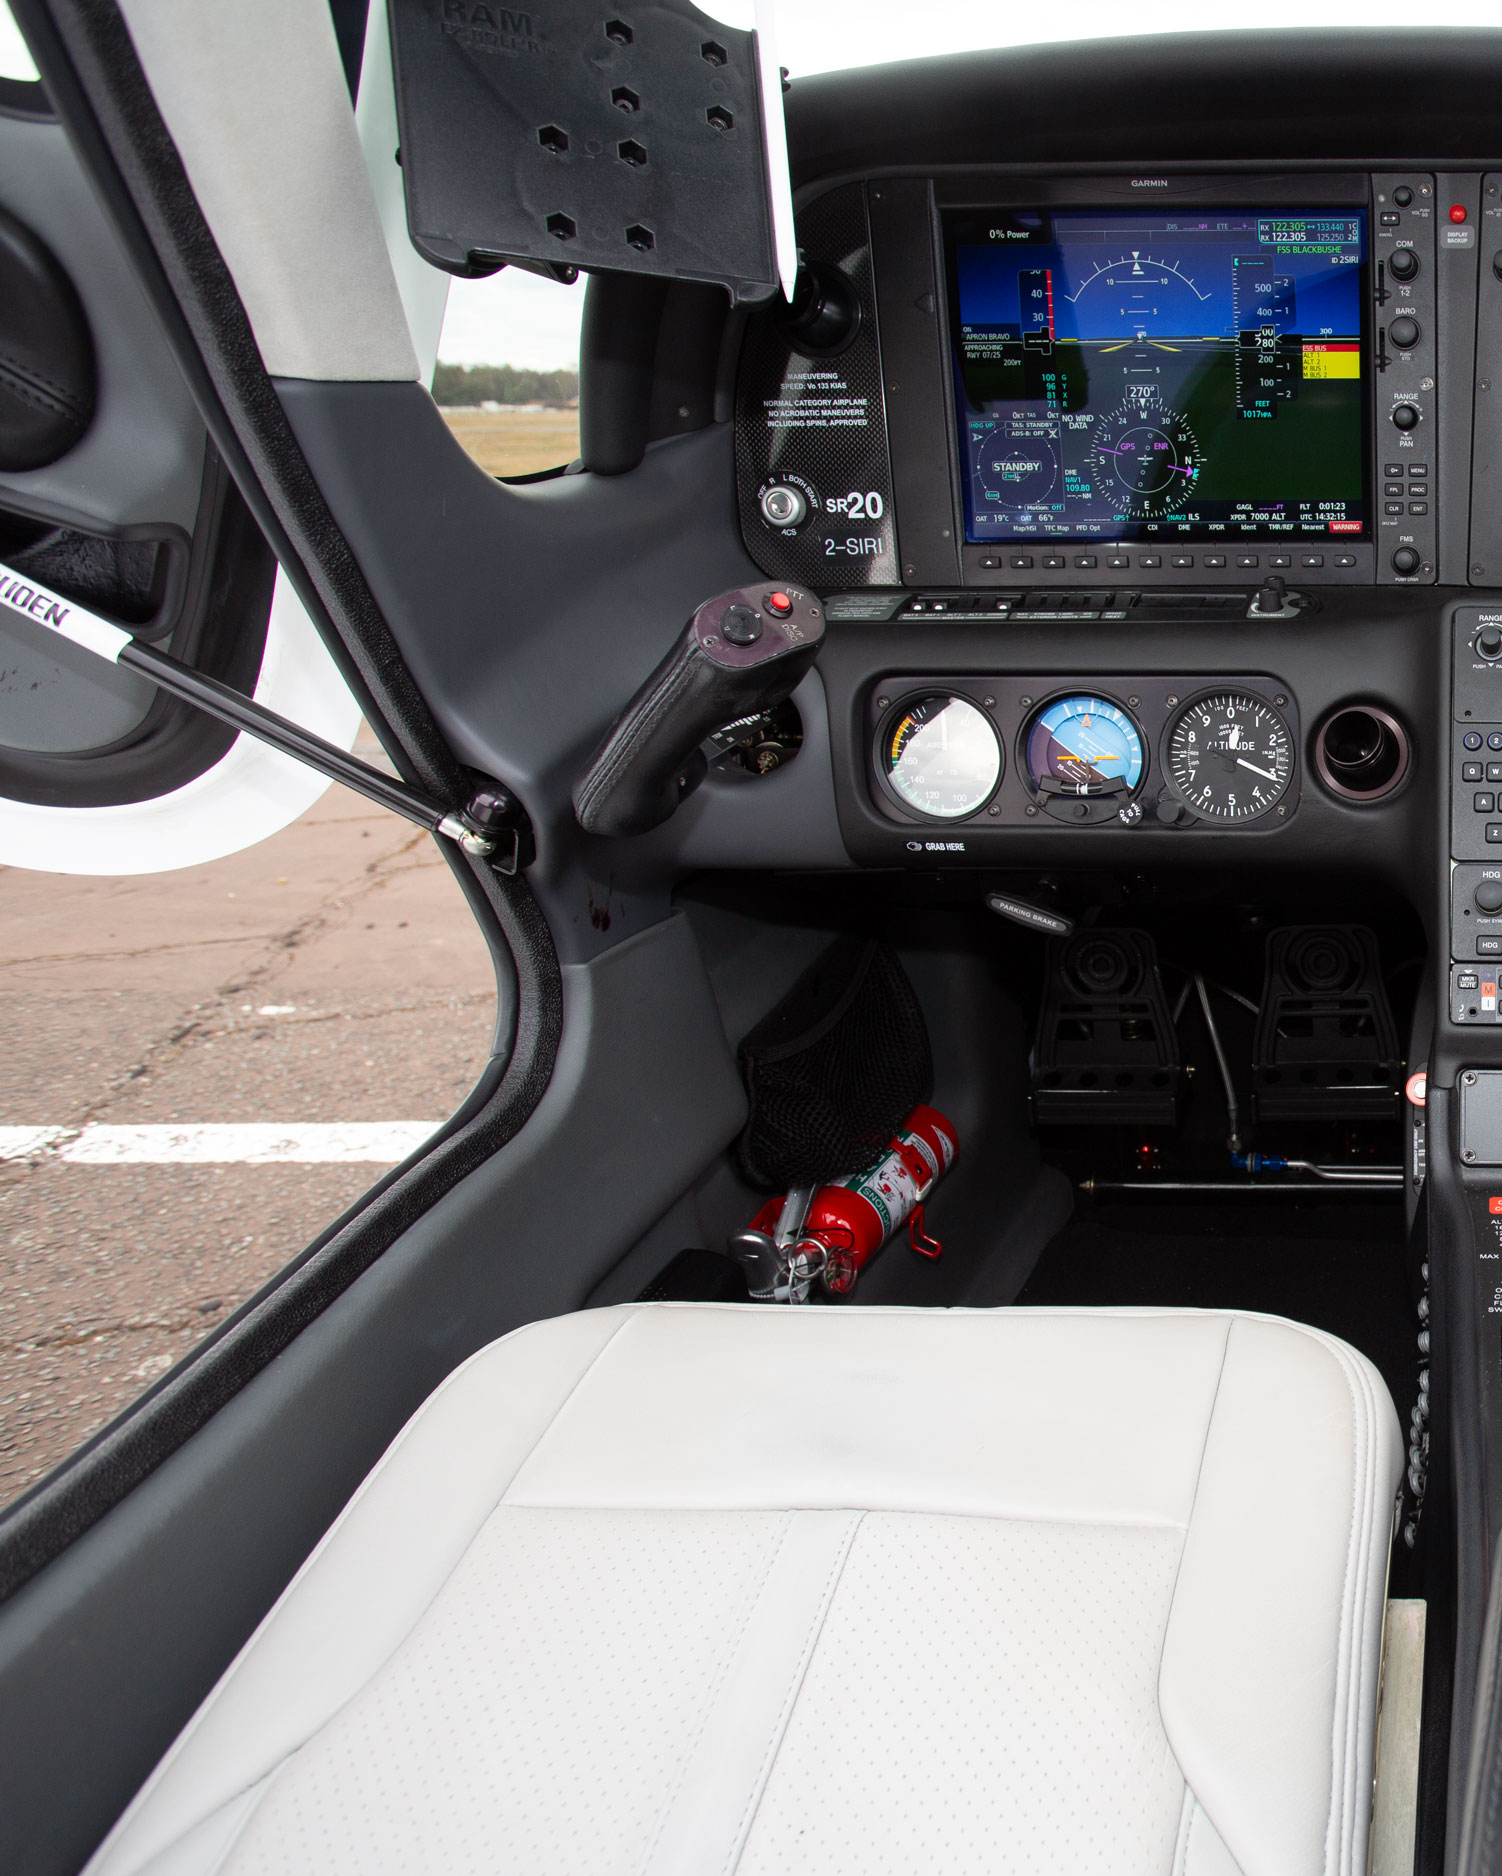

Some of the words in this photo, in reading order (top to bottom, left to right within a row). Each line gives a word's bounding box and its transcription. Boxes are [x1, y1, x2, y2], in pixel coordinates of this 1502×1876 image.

[1272, 223, 1306, 231] 122.305
[990, 230, 1004, 238] 0%
[1272, 233, 1306, 241] 122.305
[1130, 387, 1154, 397] 270°
[1069, 422, 1088, 430] DATA
[993, 462, 1039, 471] STANDBY
[826, 492, 883, 519] SR20
[1250, 513, 1269, 521] 7000
[825, 538, 883, 555] 2-SIRI
[946, 842, 965, 850] HERE
[1000, 902, 1030, 917] PARKING
[1033, 915, 1056, 927] BRAKE
